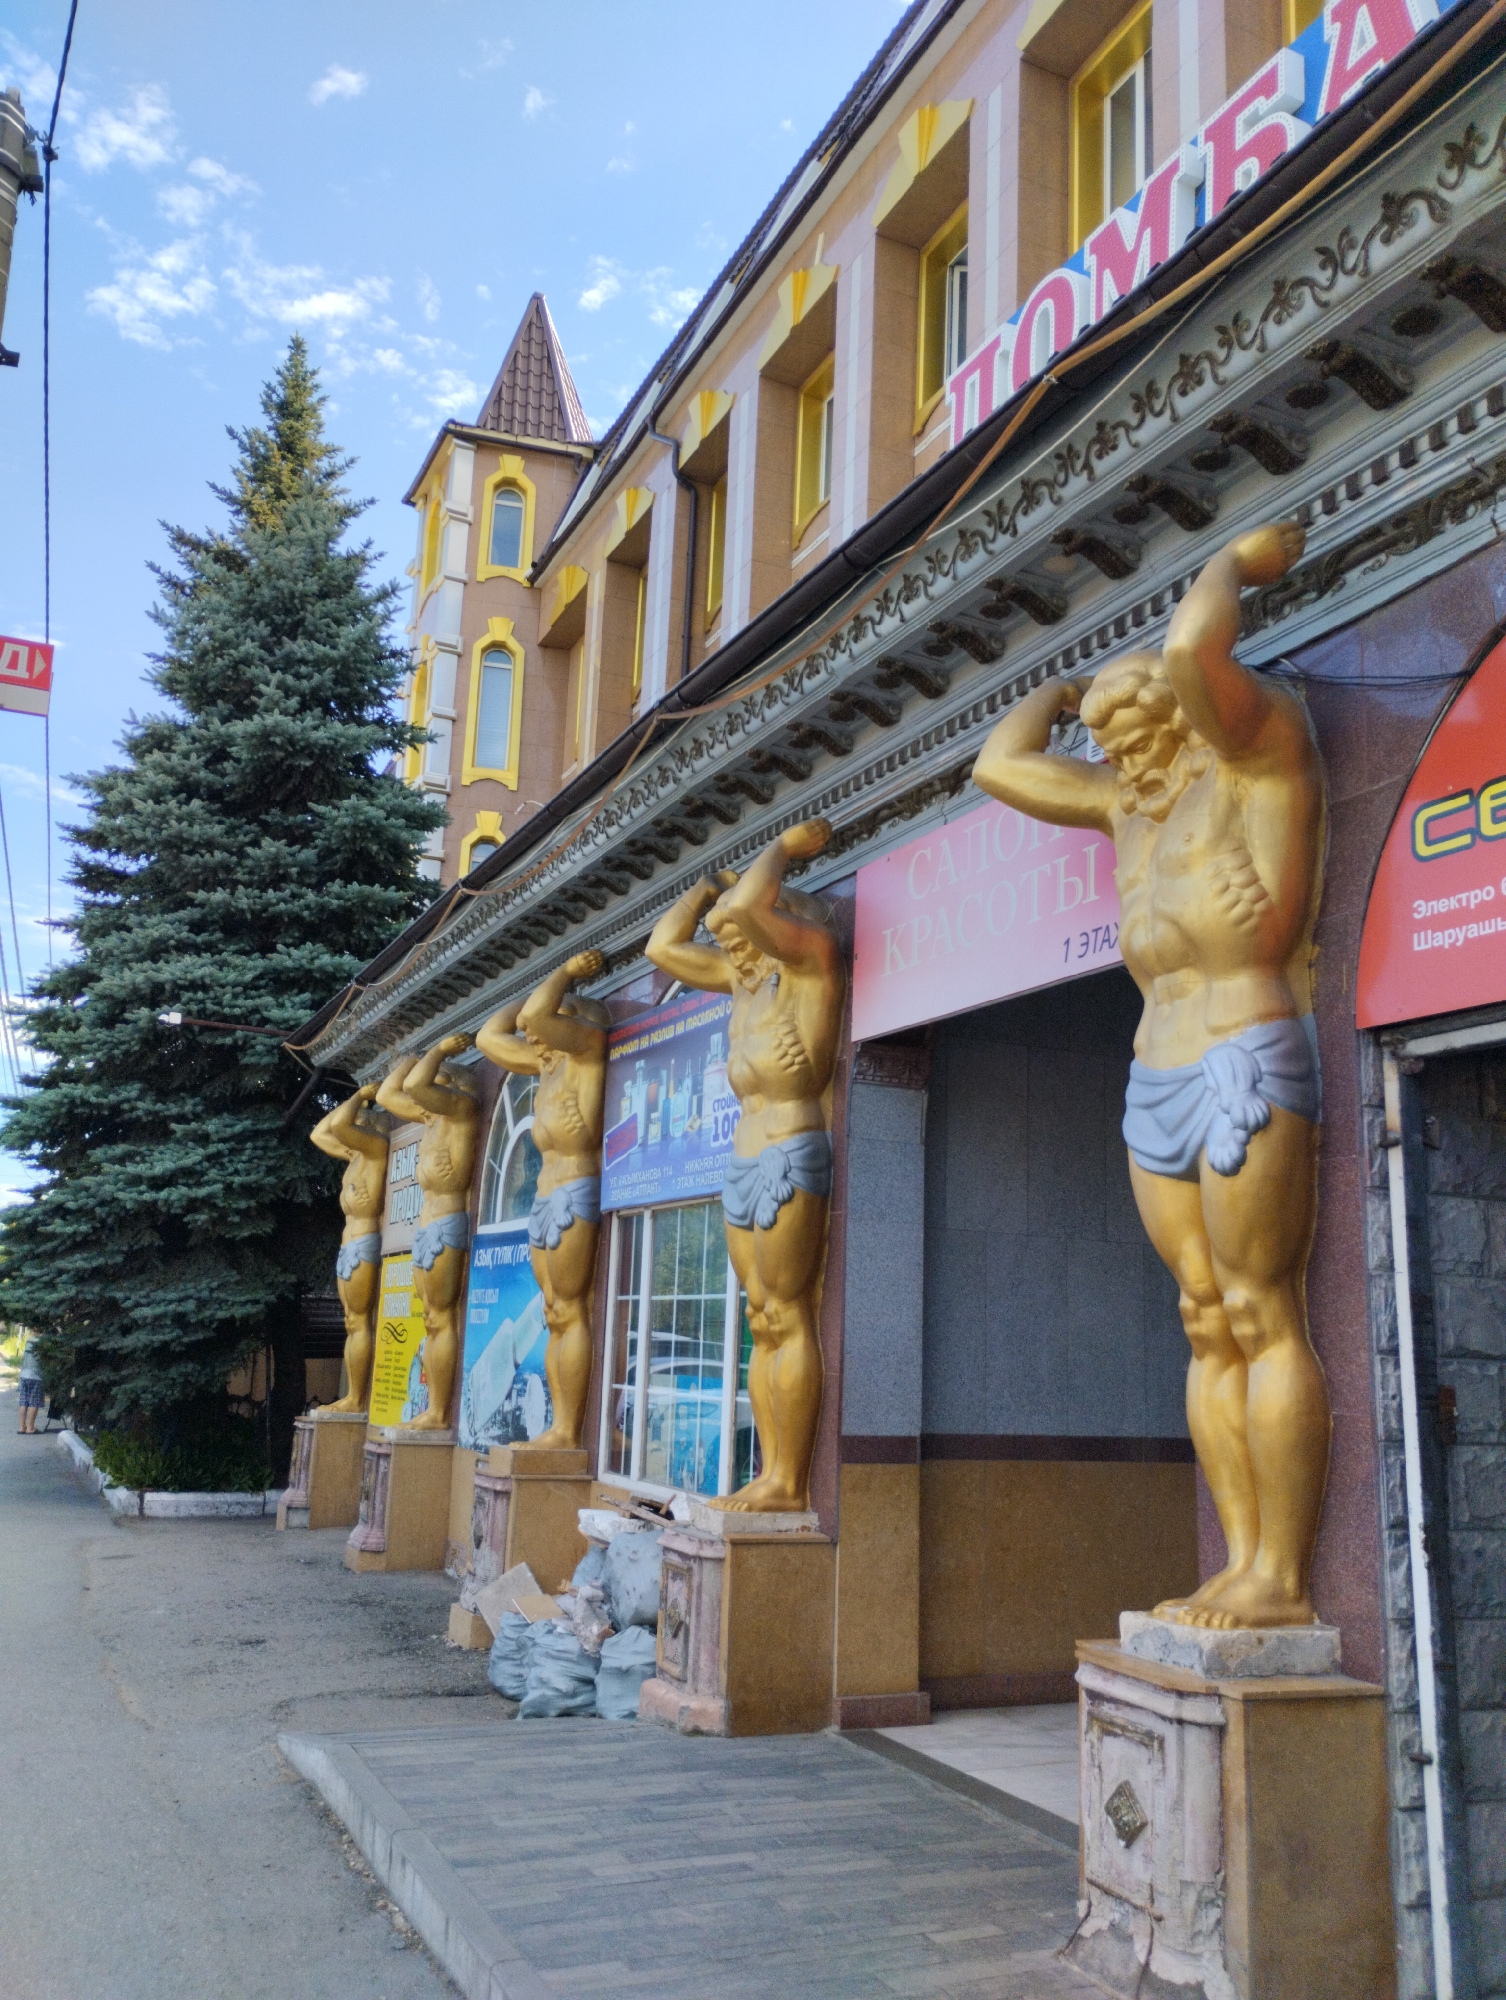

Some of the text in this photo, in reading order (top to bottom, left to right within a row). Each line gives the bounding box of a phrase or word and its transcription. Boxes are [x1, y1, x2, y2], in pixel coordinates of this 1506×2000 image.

[881, 842, 1100, 978] КРАСОТЫ
[1413, 885, 1495, 919] Электро
[1063, 937, 1070, 963] 1
[390, 1140, 421, 1182] АЗЫҚ-
